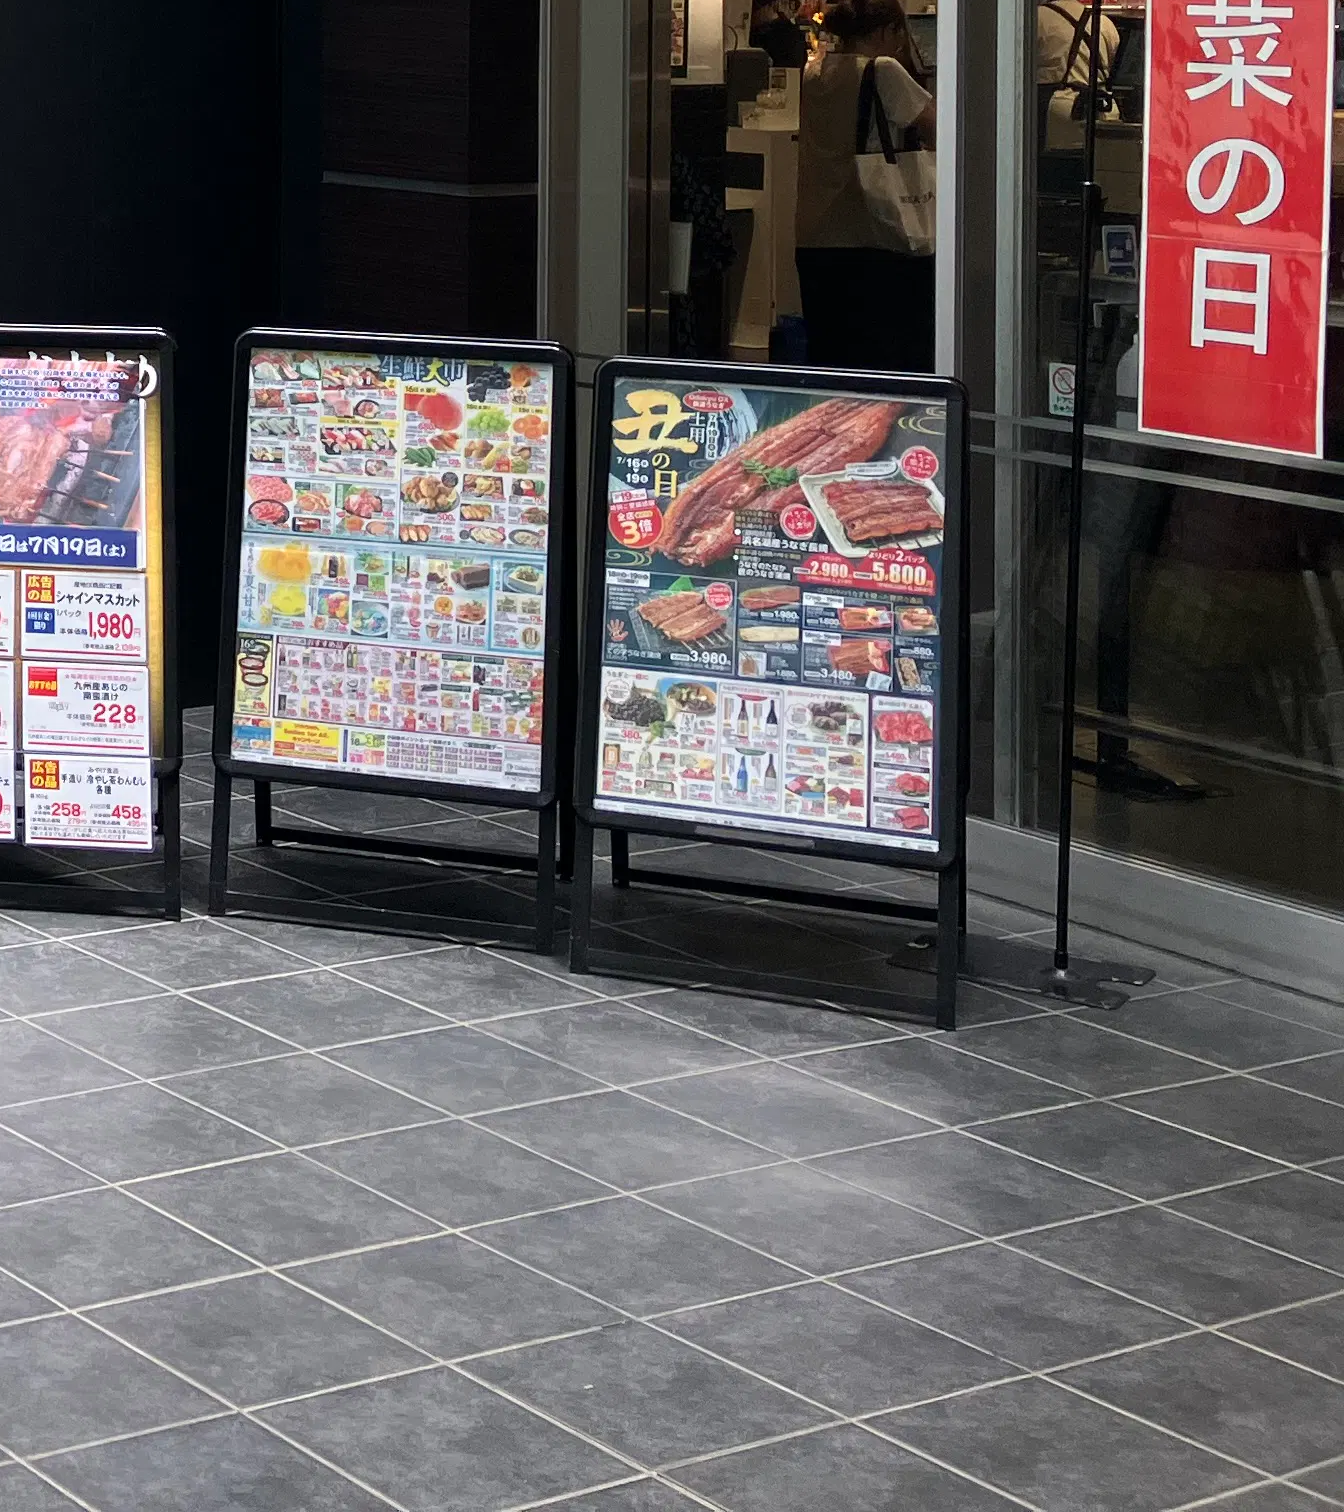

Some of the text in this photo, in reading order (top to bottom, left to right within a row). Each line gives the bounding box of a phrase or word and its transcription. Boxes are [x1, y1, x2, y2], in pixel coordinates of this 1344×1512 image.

[27, 575, 53, 588] 広告
[27, 590, 52, 602] の品
[56, 591, 141, 607] シャインマスカット
[32, 761, 58, 774] 広告
[32, 775, 58, 789] の品
